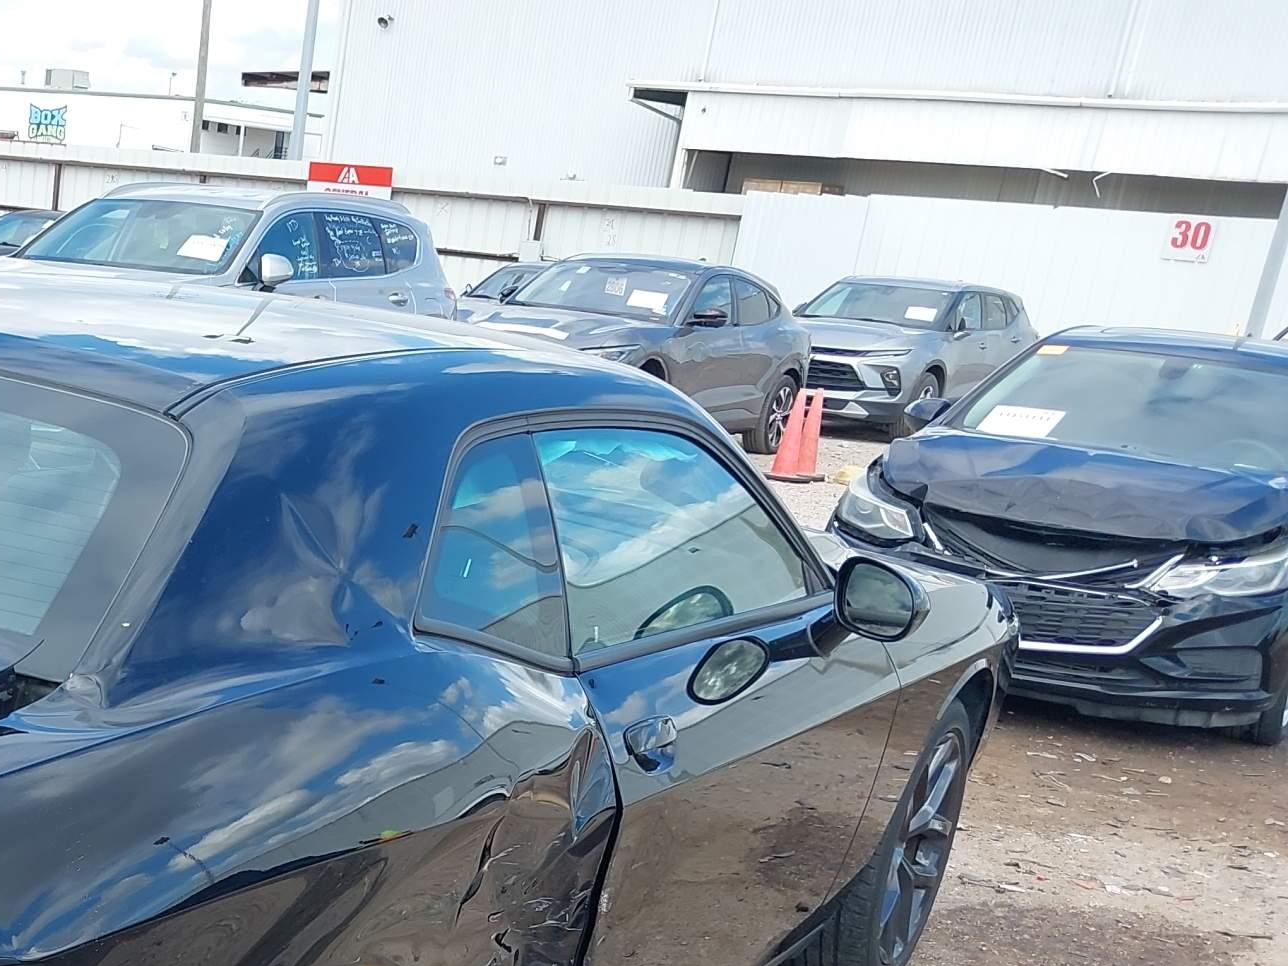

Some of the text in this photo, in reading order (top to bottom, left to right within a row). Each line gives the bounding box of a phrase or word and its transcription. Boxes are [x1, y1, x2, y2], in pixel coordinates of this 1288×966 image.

[29, 103, 68, 127] BOX
[27, 123, 66, 141] GANG
[1170, 220, 1212, 250] 30
